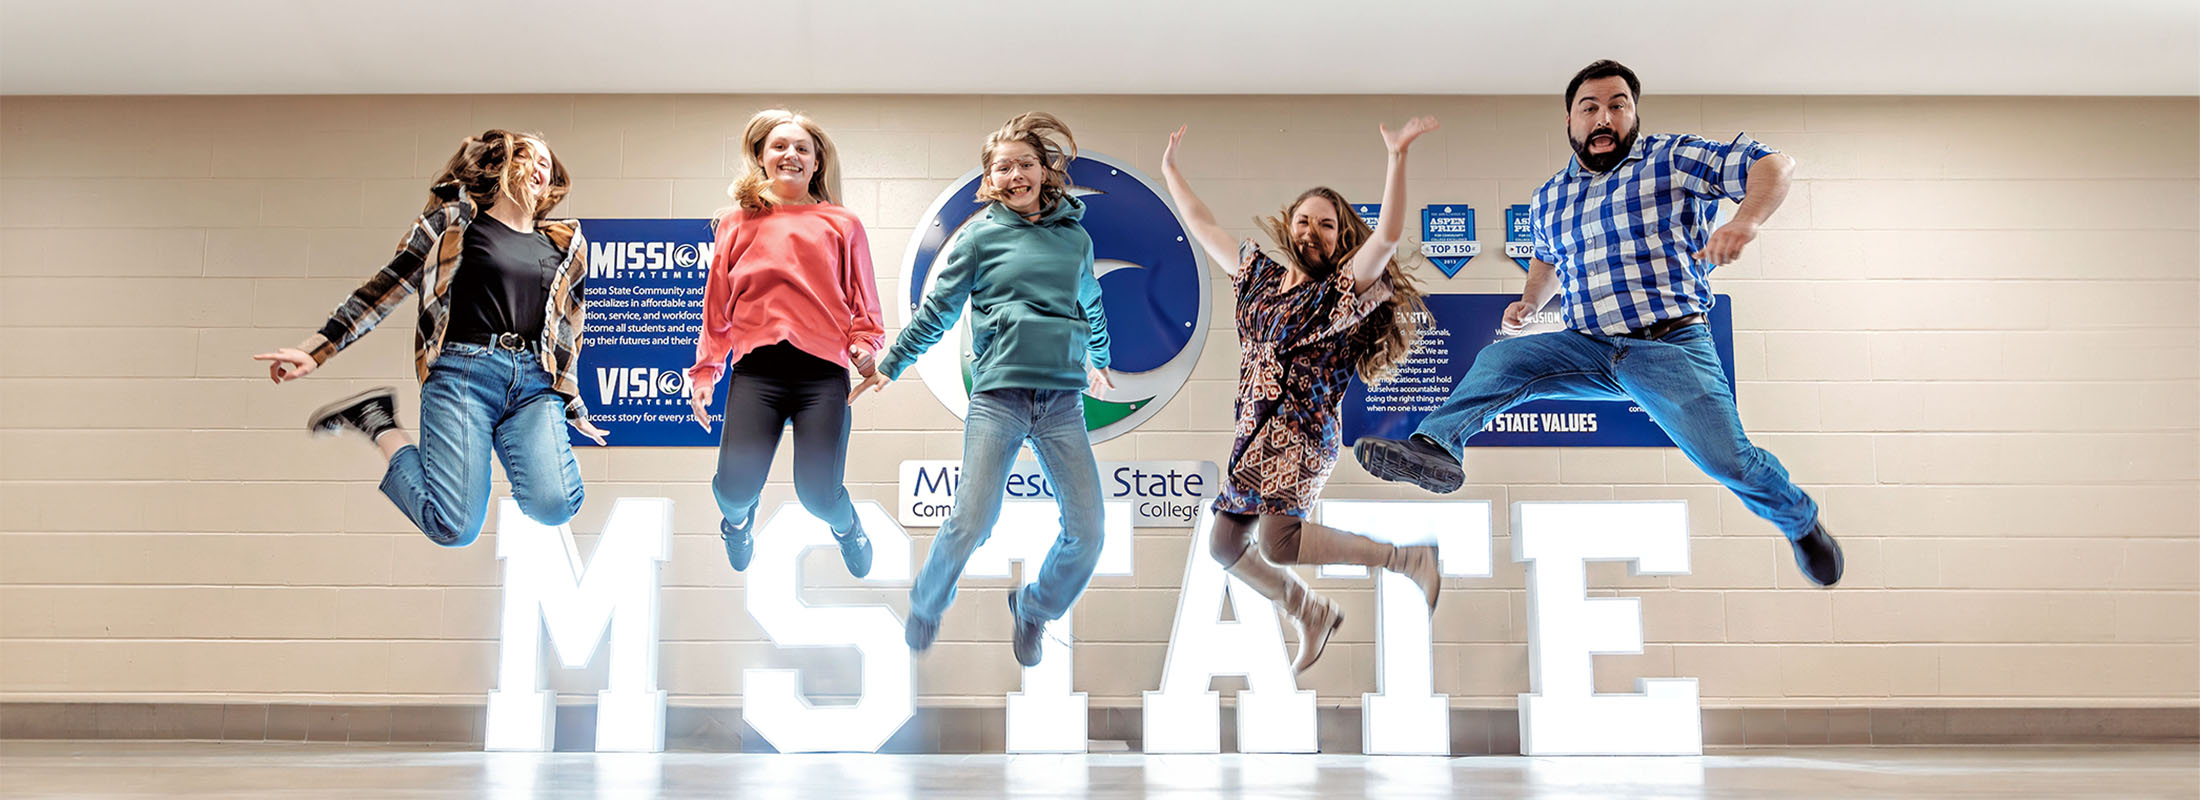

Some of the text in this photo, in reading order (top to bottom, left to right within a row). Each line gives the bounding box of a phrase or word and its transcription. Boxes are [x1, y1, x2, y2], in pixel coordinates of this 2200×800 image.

[1430, 217, 1466, 225] ASPEN
[1431, 245, 1471, 253] TOP 150
[589, 242, 715, 279] MISSION
[584, 286, 704, 297] esota State Community and
[630, 298, 639, 307] in
[640, 298, 686, 307] affordable
[687, 298, 704, 307] and
[608, 311, 641, 320] service,
[642, 311, 660, 320] and
[583, 323, 703, 335] elcome all students and eng
[597, 336, 618, 345] their
[619, 336, 650, 345] futures
[652, 336, 669, 345] and
[670, 336, 692, 345] their
[1365, 395, 1386, 403] doing
[1398, 395, 1415, 403] right
[1416, 395, 1434, 403] thing
[1366, 404, 1386, 412] when
[1412, 404, 1418, 412] is
[587, 414, 616, 422] uccess
[618, 413, 641, 424] story
[644, 412, 656, 422] for
[658, 414, 685, 424] every
[1496, 413, 1539, 432] STATE
[1540, 413, 1598, 432] VALUES
[913, 466, 1204, 498] Mieso State
